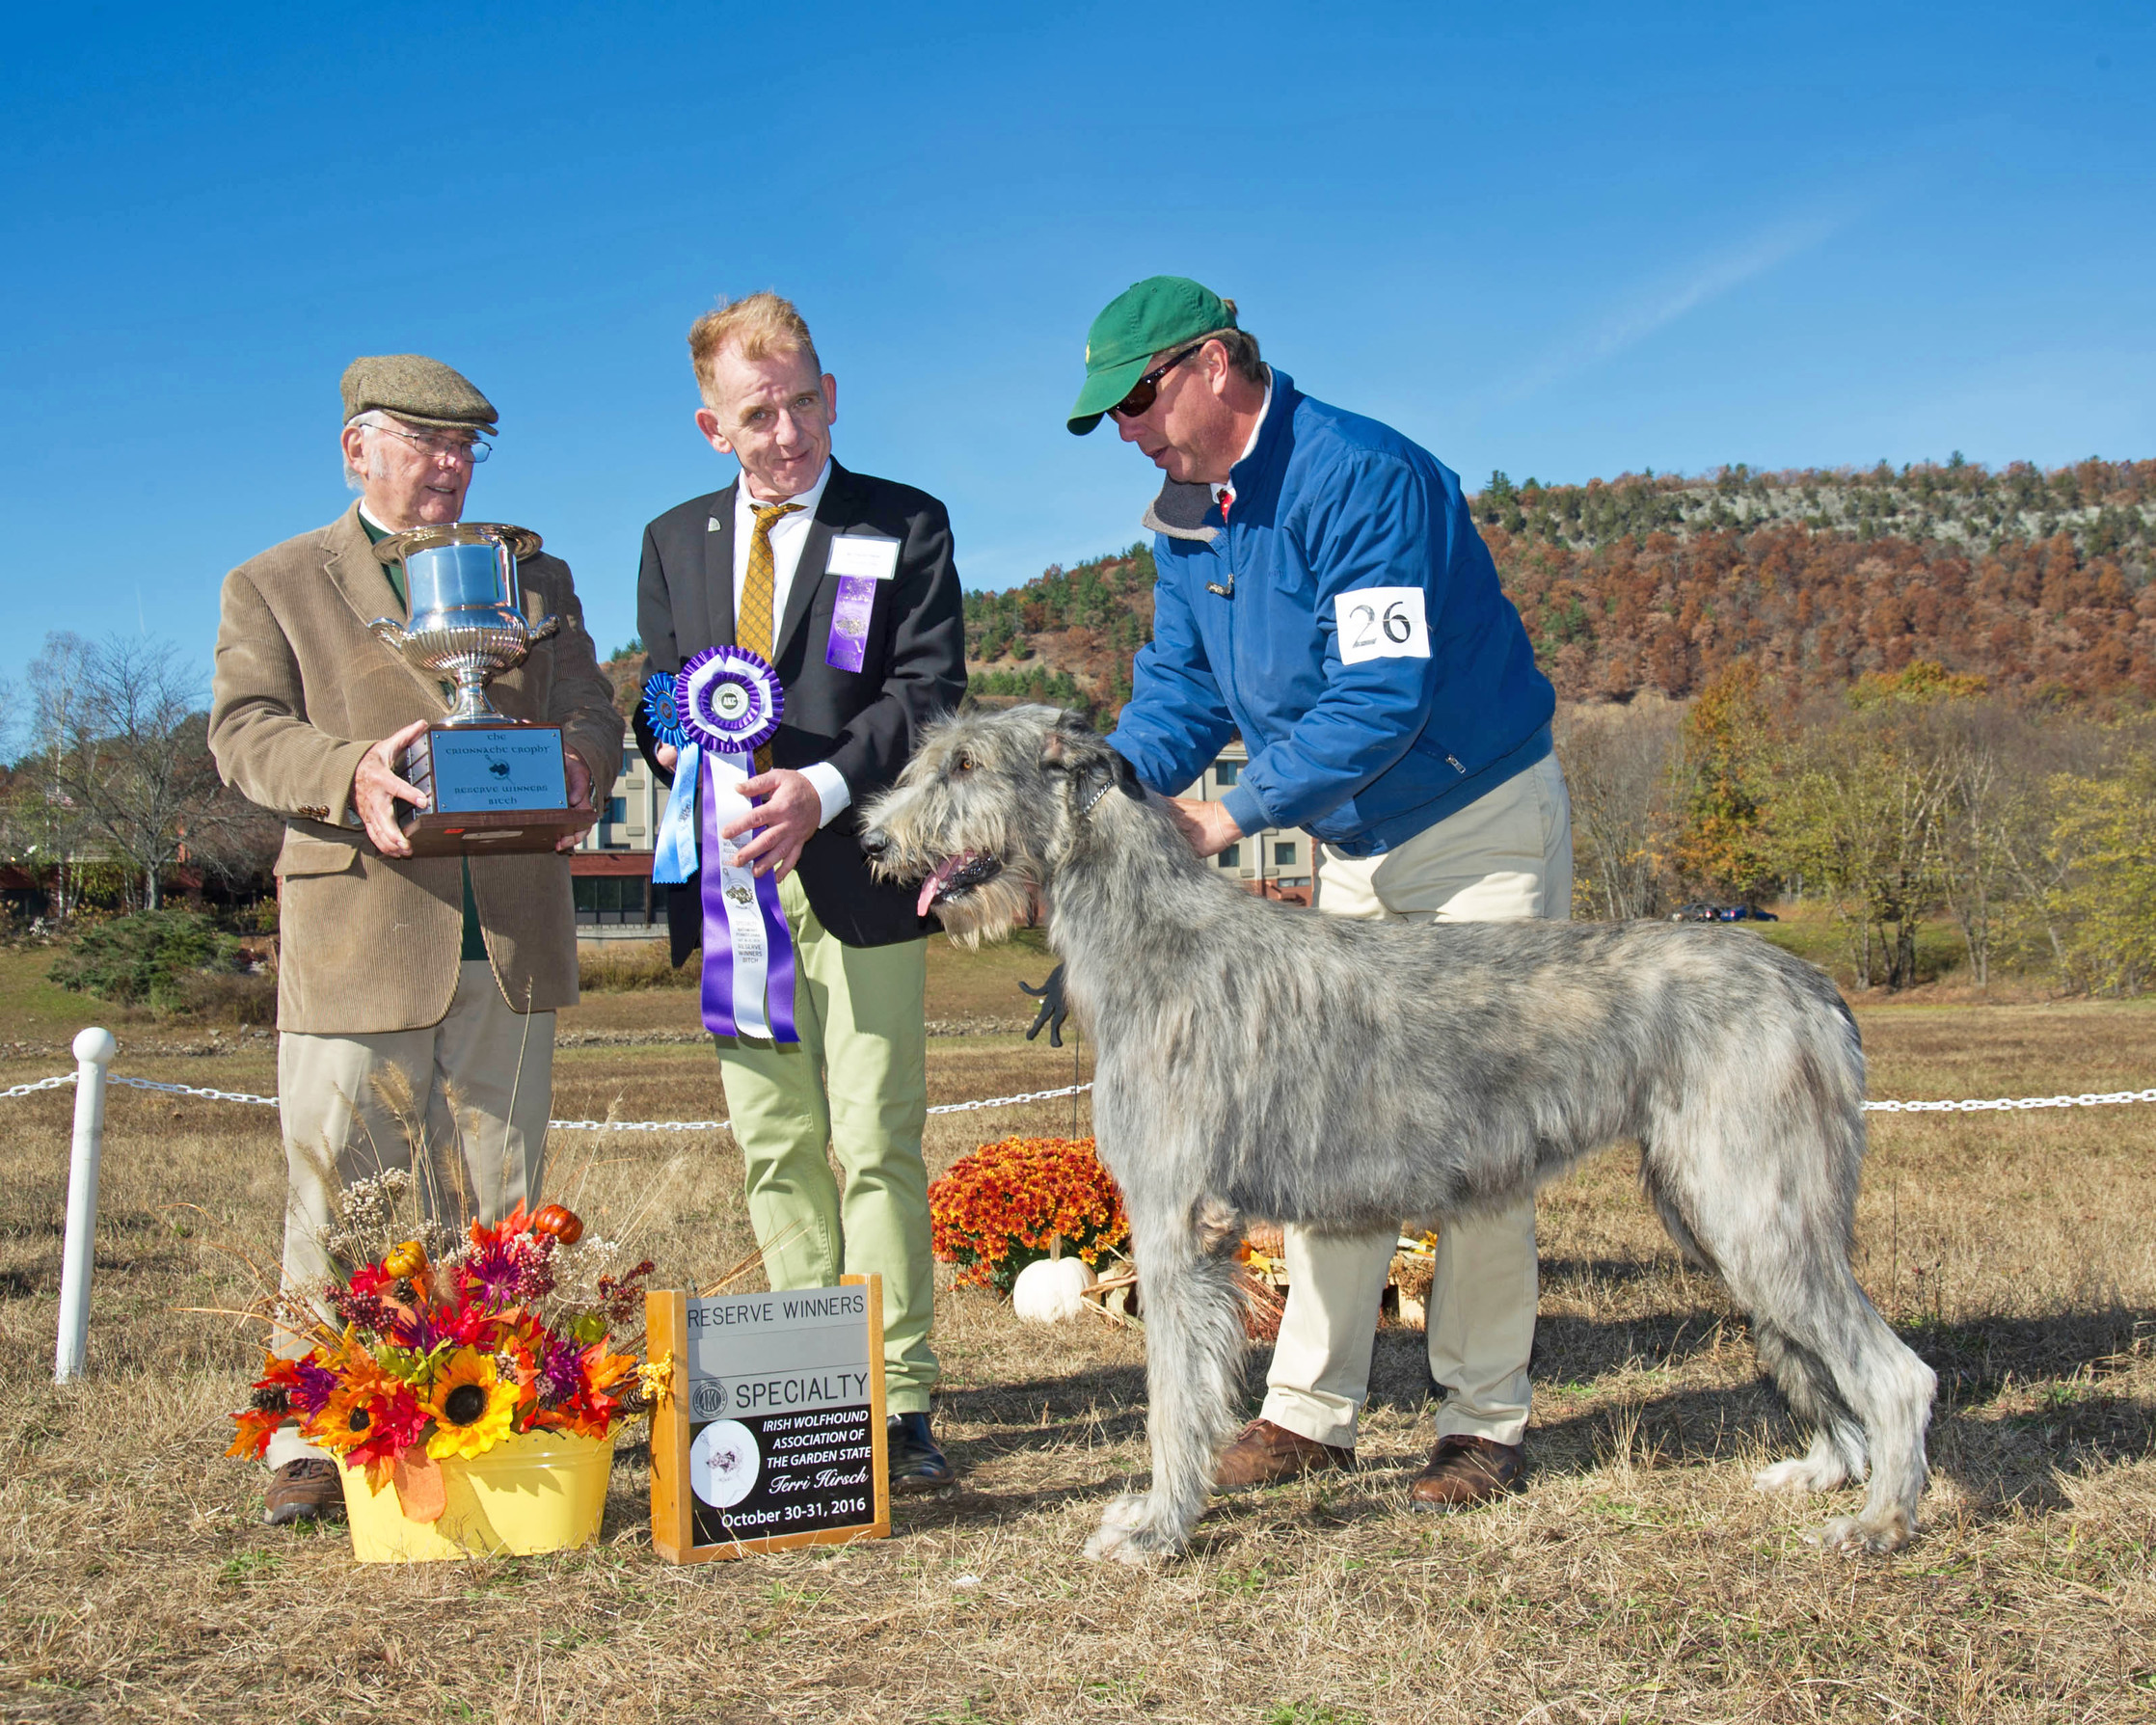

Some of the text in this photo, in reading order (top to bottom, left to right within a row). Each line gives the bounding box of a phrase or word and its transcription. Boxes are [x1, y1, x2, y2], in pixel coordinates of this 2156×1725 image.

[1349, 601, 1412, 649] 26
[687, 1295, 864, 1329] RESERVE WINNERS
[736, 1372, 868, 1409] SPECIALTY
[763, 1410, 869, 1433] IRISH WOLFHOUND
[772, 1428, 866, 1450] ASSOCIATION OF
[767, 1446, 872, 1469] THE GARDEN STATE
[768, 1466, 870, 1495] Terri Hirsch
[721, 1497, 866, 1528] October 30-31, 2016
